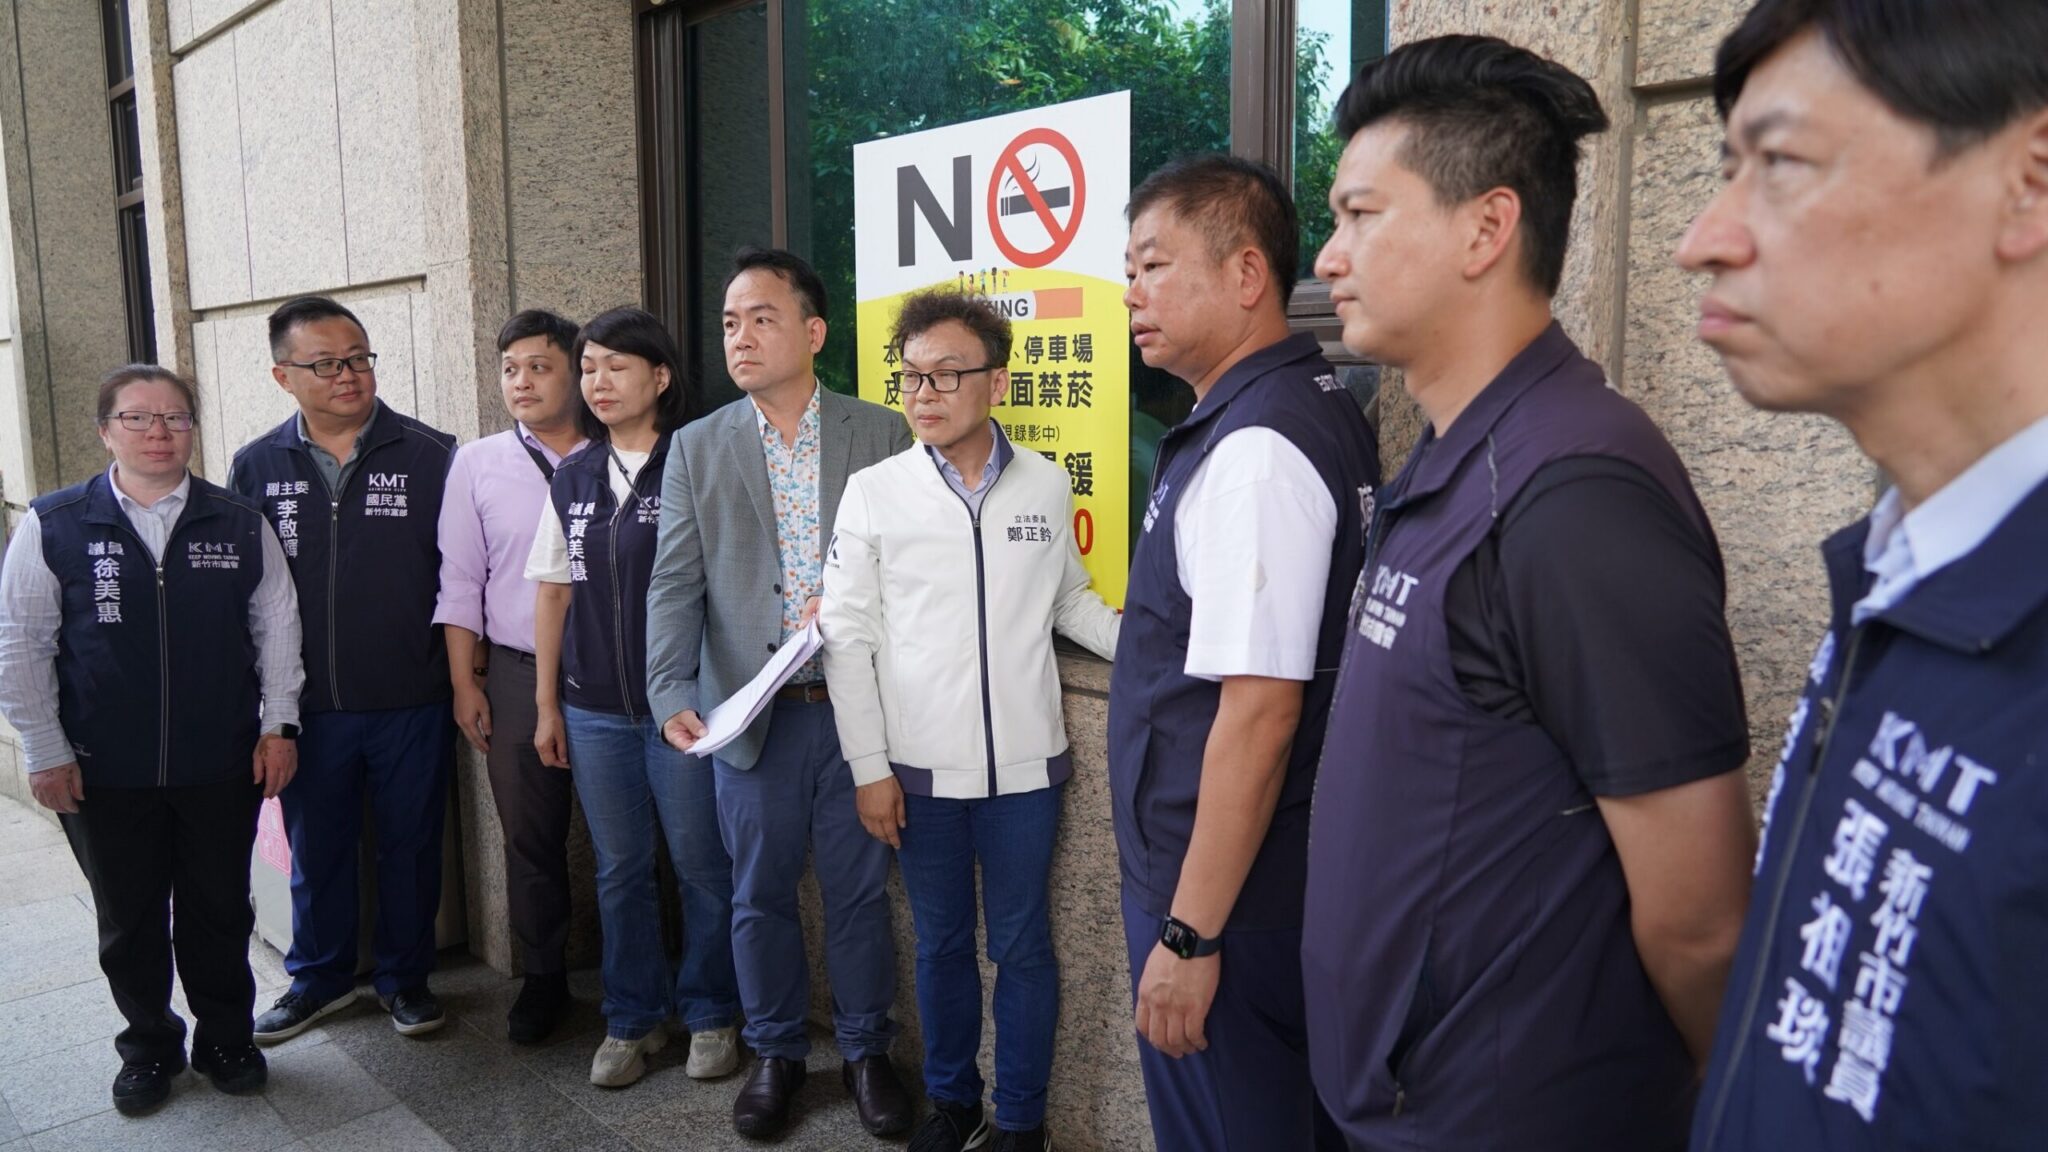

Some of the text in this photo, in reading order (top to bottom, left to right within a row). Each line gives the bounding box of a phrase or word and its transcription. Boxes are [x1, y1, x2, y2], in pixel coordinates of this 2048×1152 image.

[987, 298, 1029, 318] ING
[368, 473, 408, 488] KMT
[266, 481, 309, 497] 副主委
[366, 493, 408, 508] 國民黨
[1014, 514, 1048, 524] 立法委員
[1007, 526, 1052, 543] 鄭正鈐
[88, 541, 125, 556] 議員
[188, 542, 237, 554] KMT
[568, 518, 589, 581] 黃美慧
[93, 557, 123, 623] 徐美惠
[1868, 711, 1998, 816] KMT
